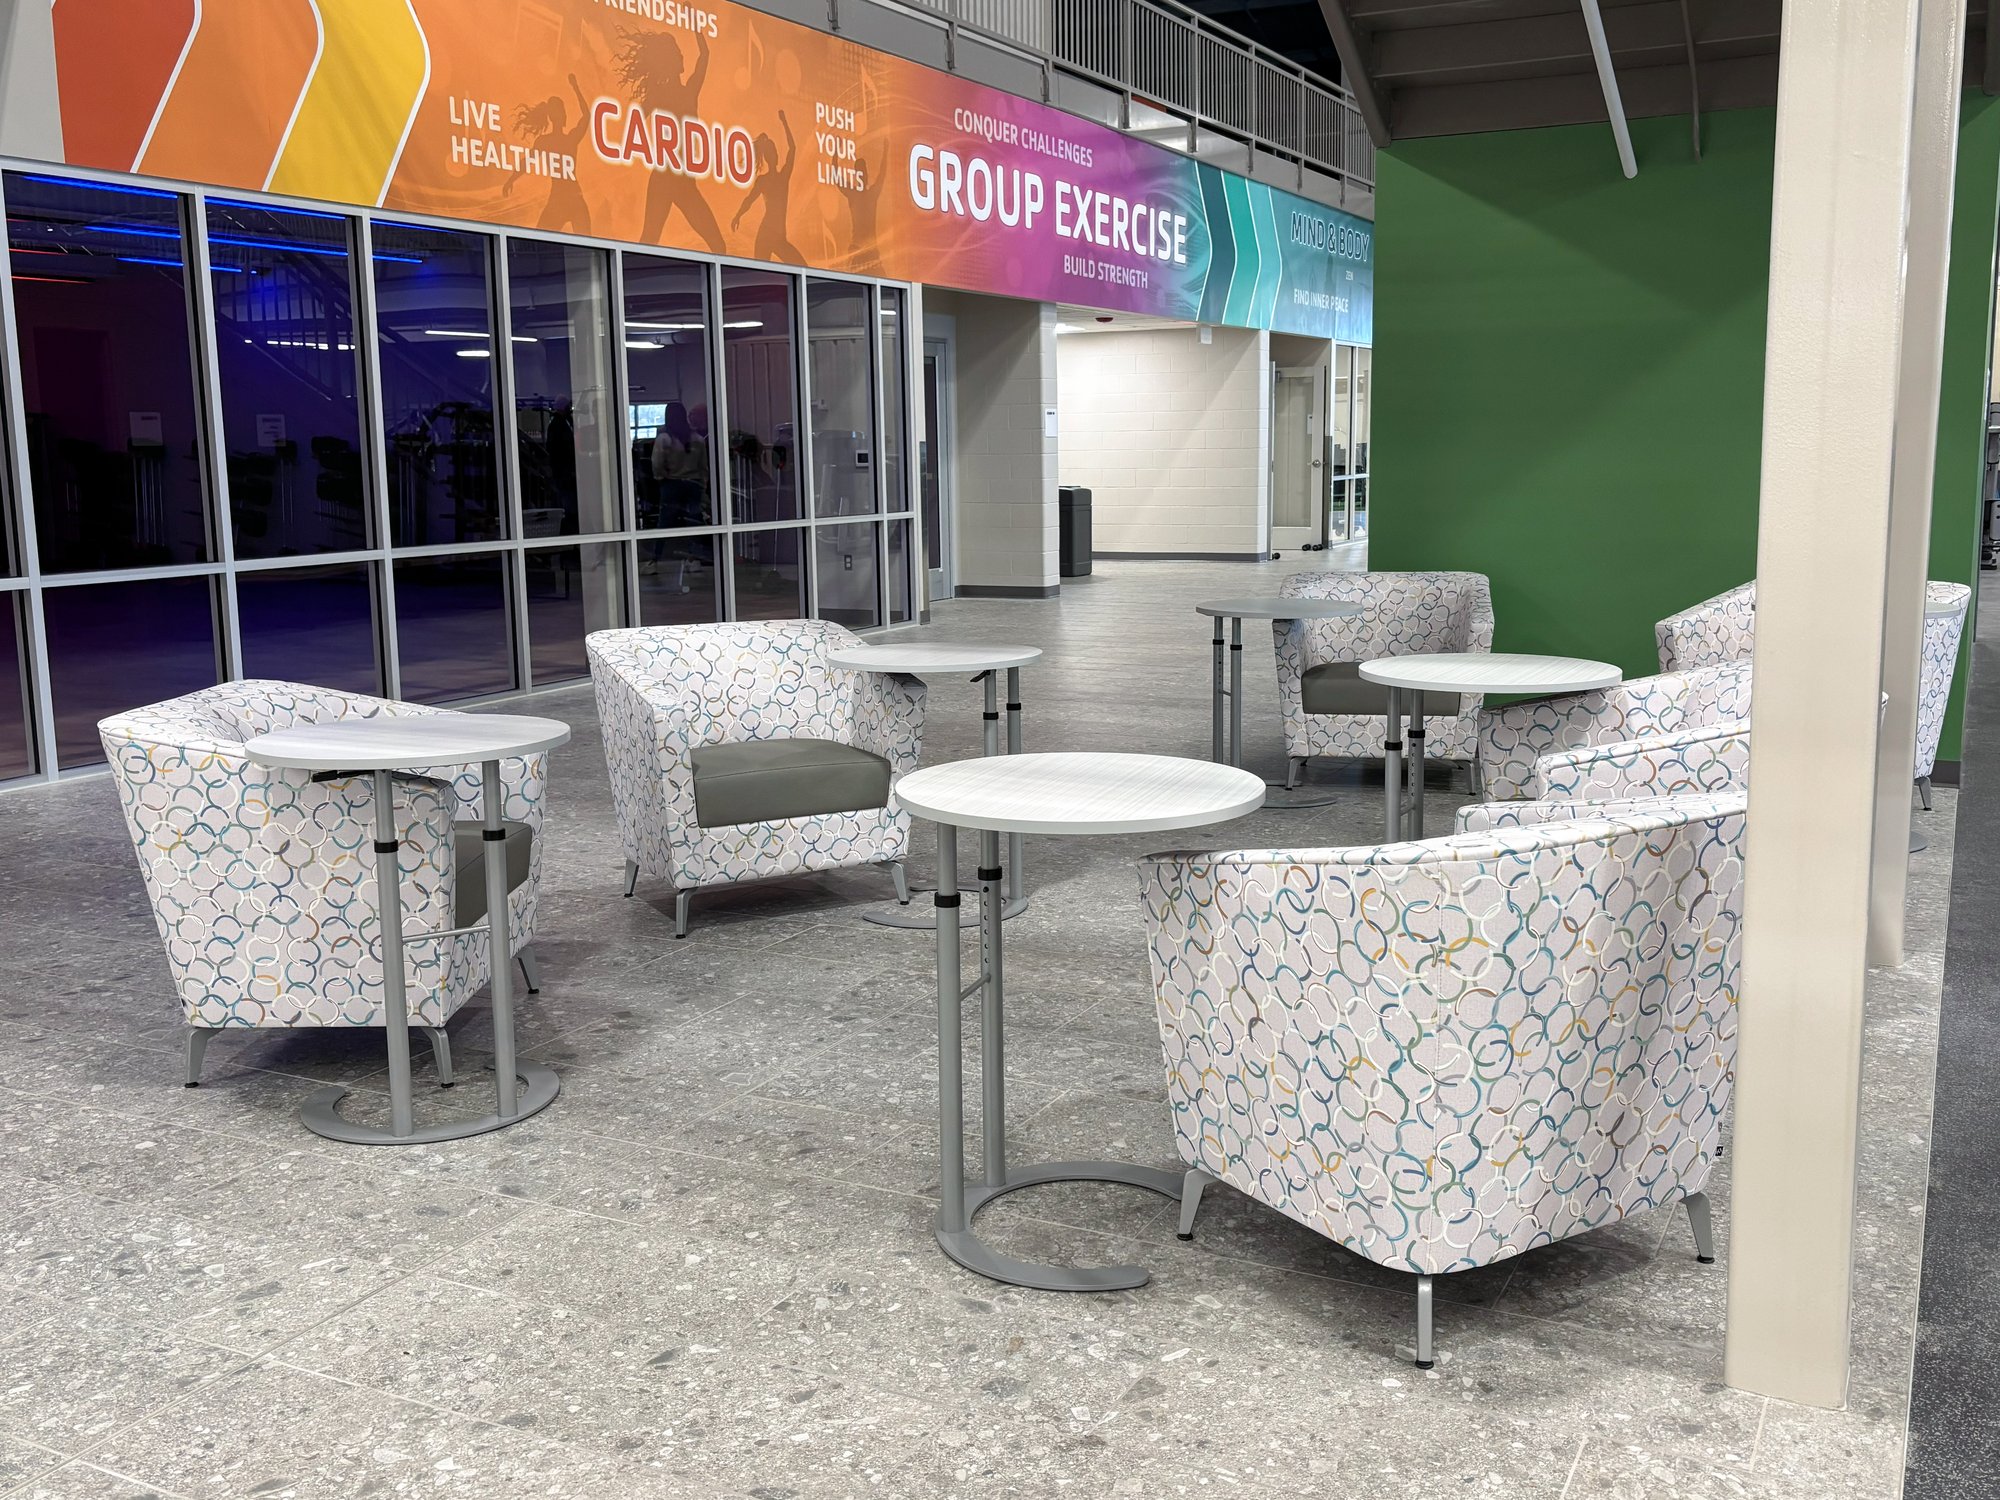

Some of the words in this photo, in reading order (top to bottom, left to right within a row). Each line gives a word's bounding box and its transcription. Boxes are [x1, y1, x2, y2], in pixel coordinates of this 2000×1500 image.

[593, 0, 718, 38] ENDSHIPS
[449, 96, 501, 131] LIVE
[815, 102, 855, 133] PUSH
[593, 100, 755, 186] CARDIO
[816, 131, 856, 162] YOUR
[954, 107, 1018, 146] CONQUER
[1021, 127, 1093, 168] CHALLENGES
[451, 135, 576, 181] HEALTHIER
[817, 162, 864, 192] LIMITS
[909, 143, 1044, 230] GROUP
[1055, 180, 1187, 264] EXERCISE
[1291, 211, 1325, 250] MIND
[1327, 222, 1337, 254] &
[1338, 226, 1370, 262] BODY
[1063, 254, 1095, 279] BUILD
[1097, 262, 1149, 289] STRENGTH
[1345, 270, 1354, 281] ZEN
[1293, 288, 1309, 306] FIND
[1310, 292, 1329, 310] INNER
[1330, 296, 1349, 313] PEACE
